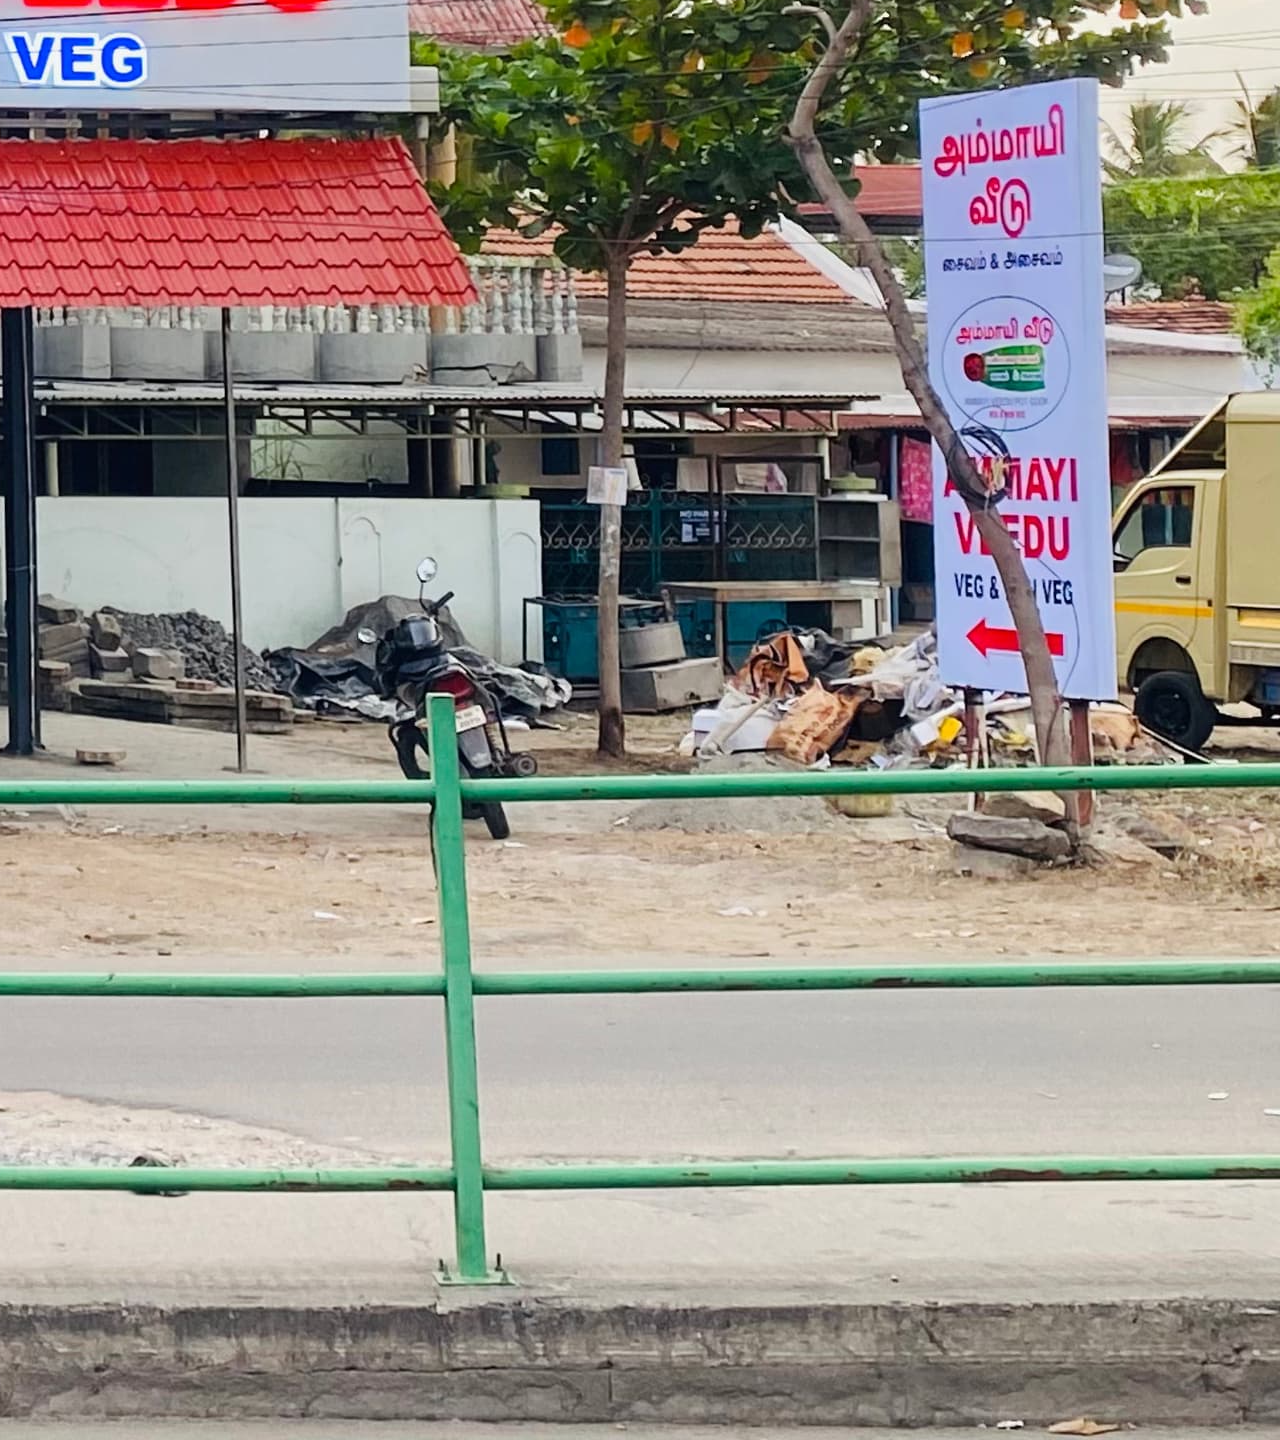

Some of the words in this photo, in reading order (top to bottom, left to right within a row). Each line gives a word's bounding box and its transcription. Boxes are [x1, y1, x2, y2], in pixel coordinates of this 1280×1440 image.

[13, 36, 143, 84] VEG
[933, 103, 1066, 178] அம்மாயி
[968, 175, 1033, 239] வீடு
[943, 249, 987, 271] சைவம்
[990, 252, 999, 269] &
[1003, 244, 1064, 269] அசைவம்
[1023, 316, 1054, 345] வீடு
[954, 572, 984, 599] VEG
[989, 575, 1000, 599] &
[1042, 578, 1074, 605] VEG
